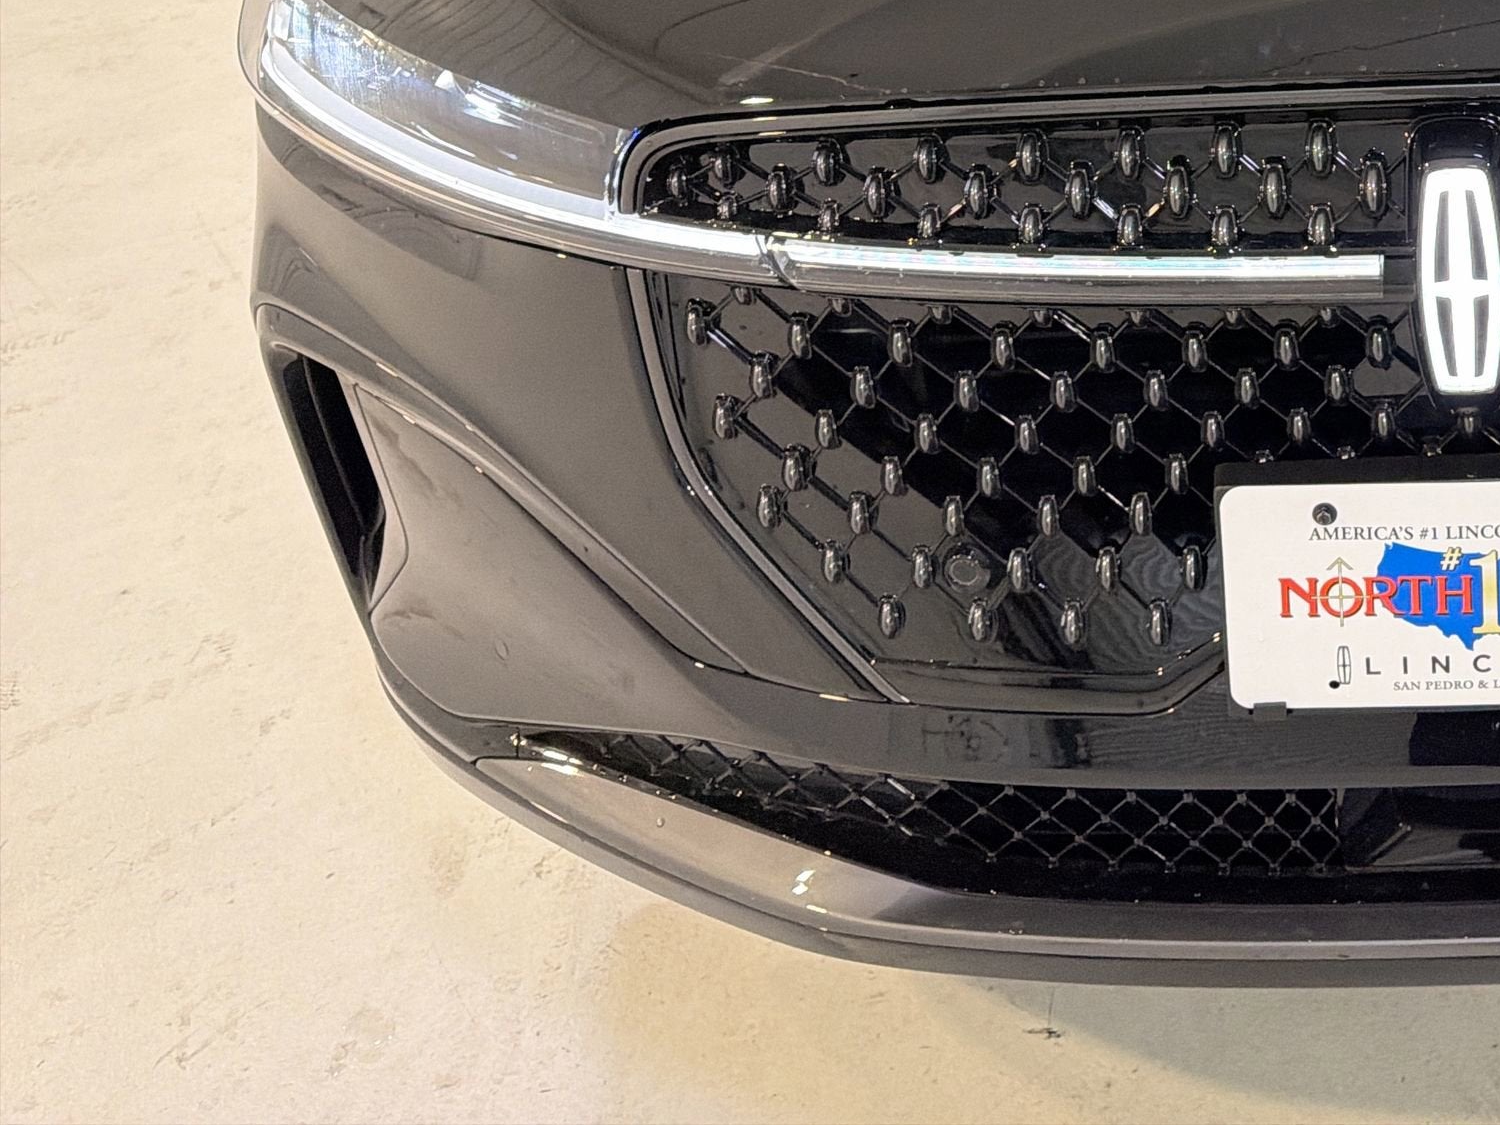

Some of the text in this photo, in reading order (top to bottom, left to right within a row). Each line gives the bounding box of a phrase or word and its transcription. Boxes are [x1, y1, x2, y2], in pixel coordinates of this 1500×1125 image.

[1419, 527, 1438, 540] #1
[1279, 573, 1475, 619] NORTH
[1393, 681, 1421, 691] SAN
[1425, 680, 1474, 690] PEDRO
[1477, 679, 1490, 689] &
